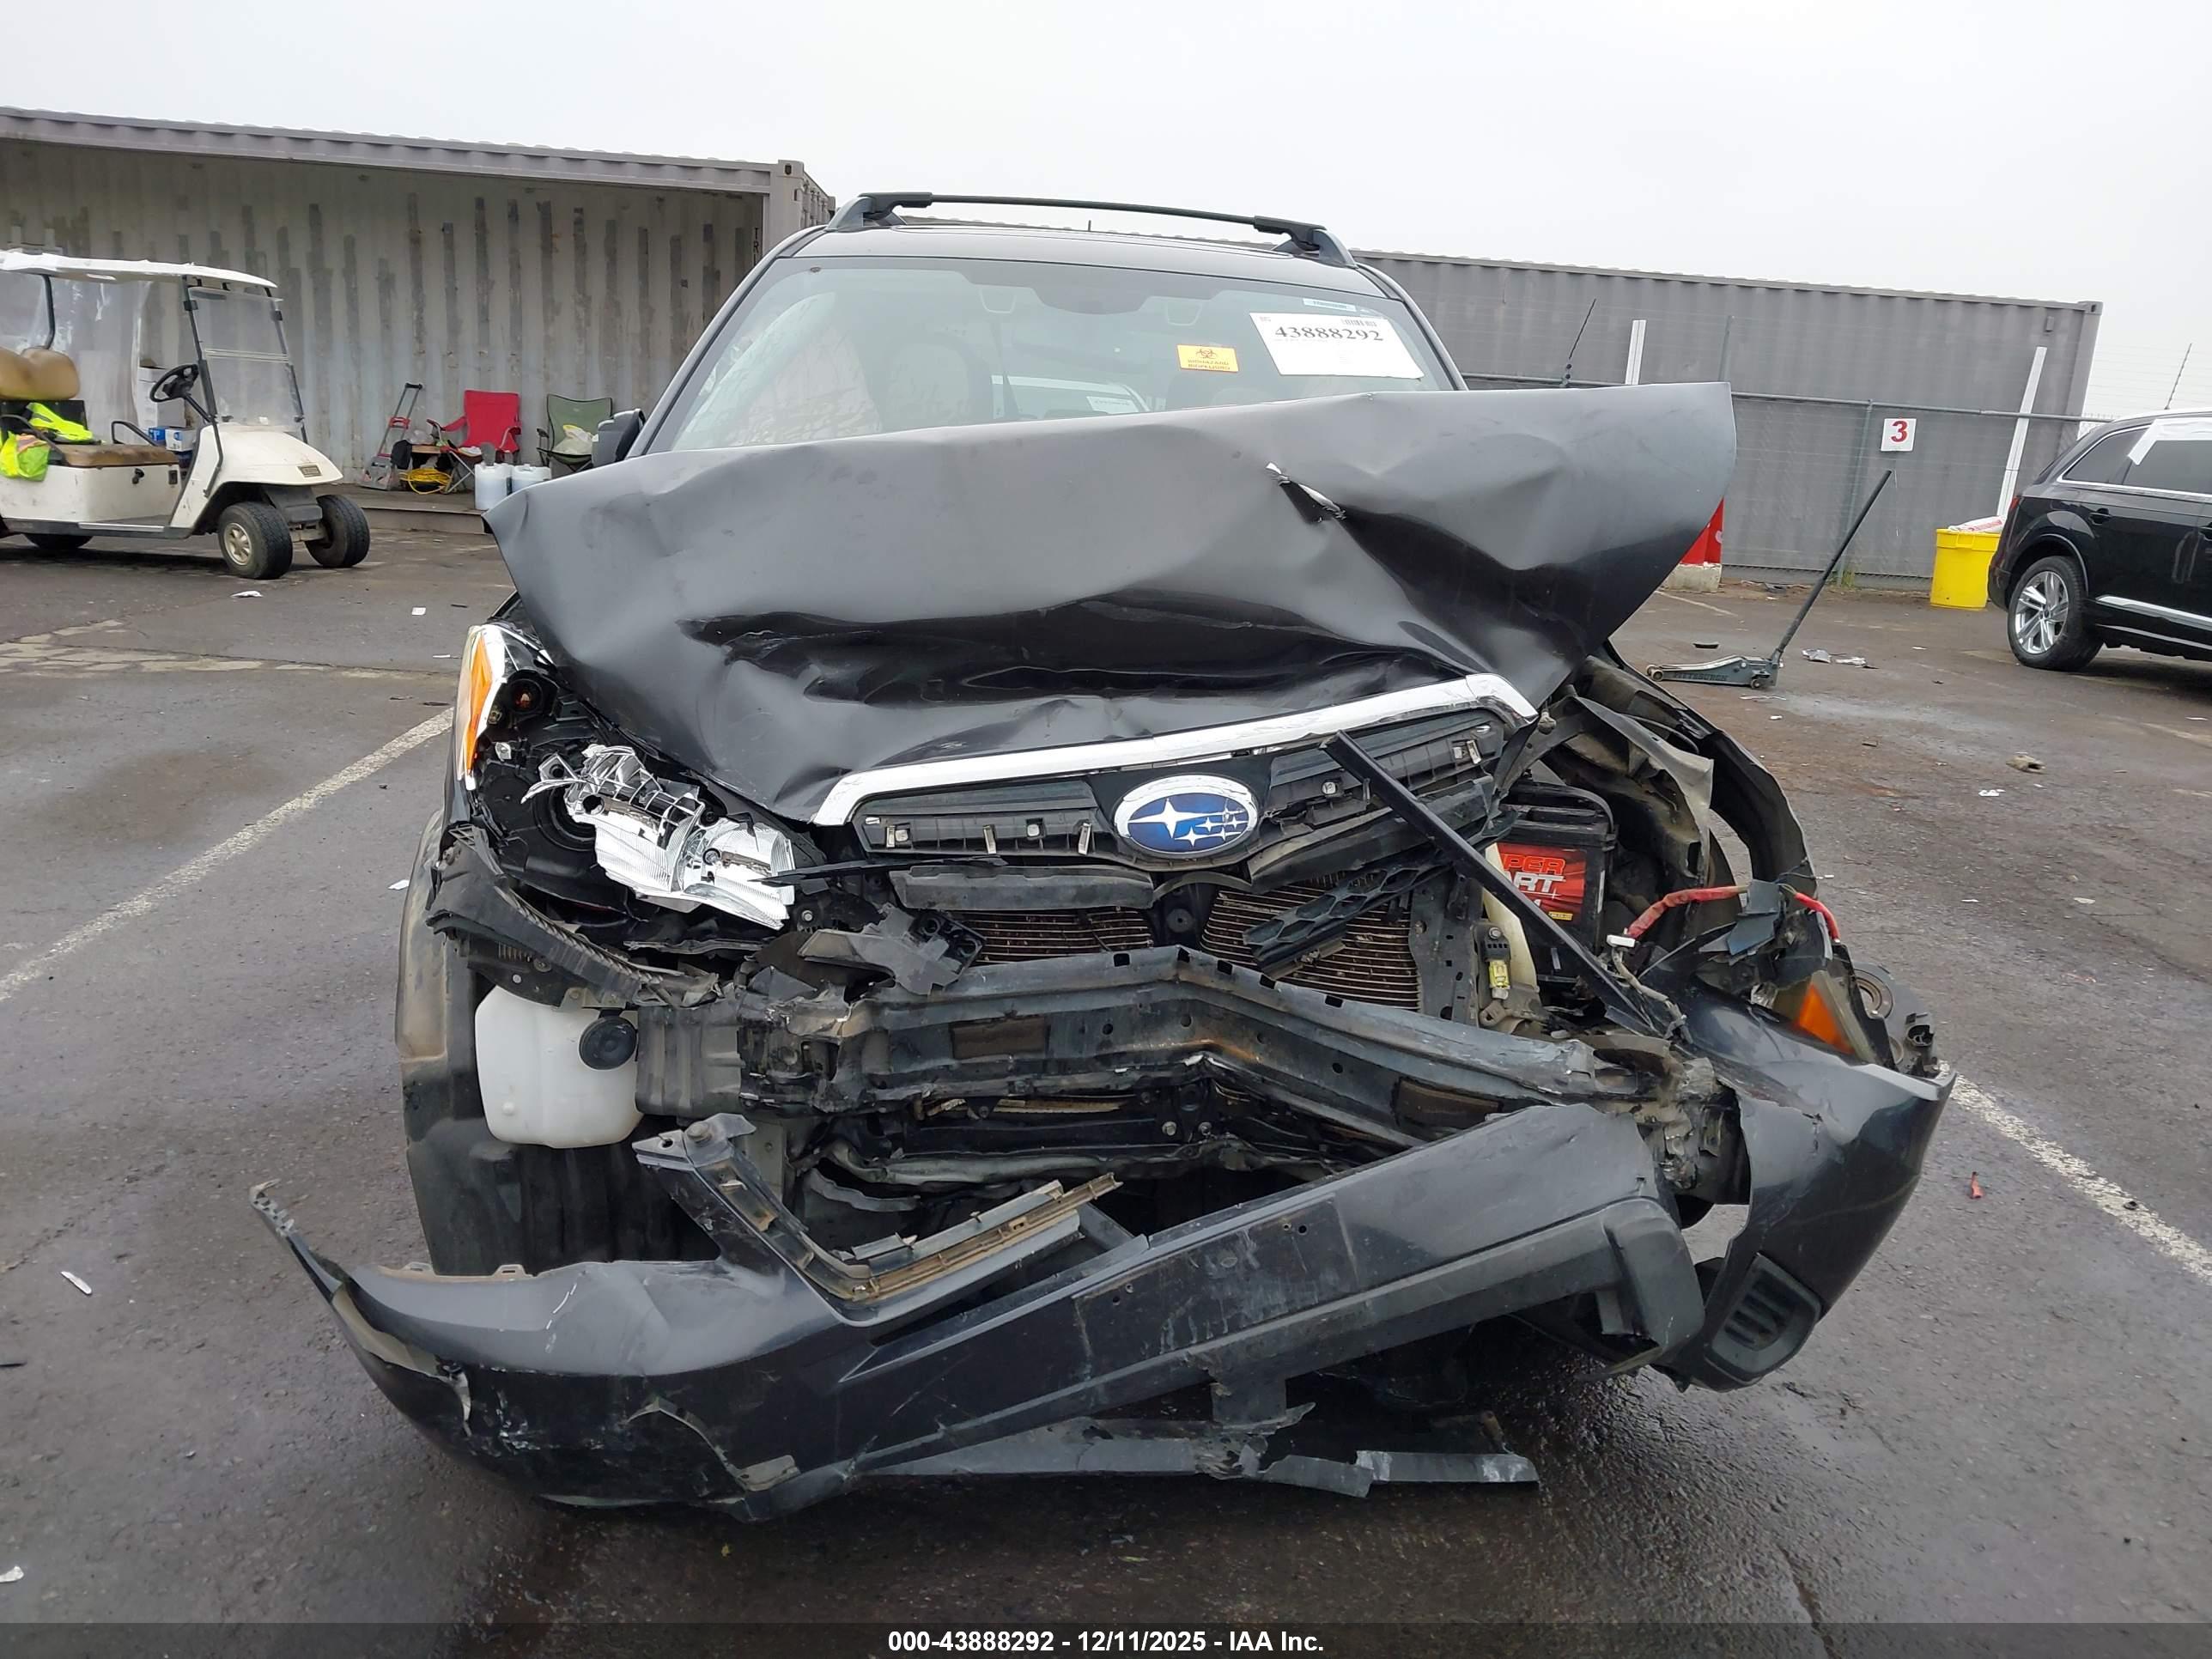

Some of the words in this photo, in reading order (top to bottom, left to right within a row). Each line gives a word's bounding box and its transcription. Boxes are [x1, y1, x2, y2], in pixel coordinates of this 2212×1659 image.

[1274, 325, 1383, 342] 43888292
[1891, 420, 1908, 443] 3
[1500, 854, 1566, 876] PER
